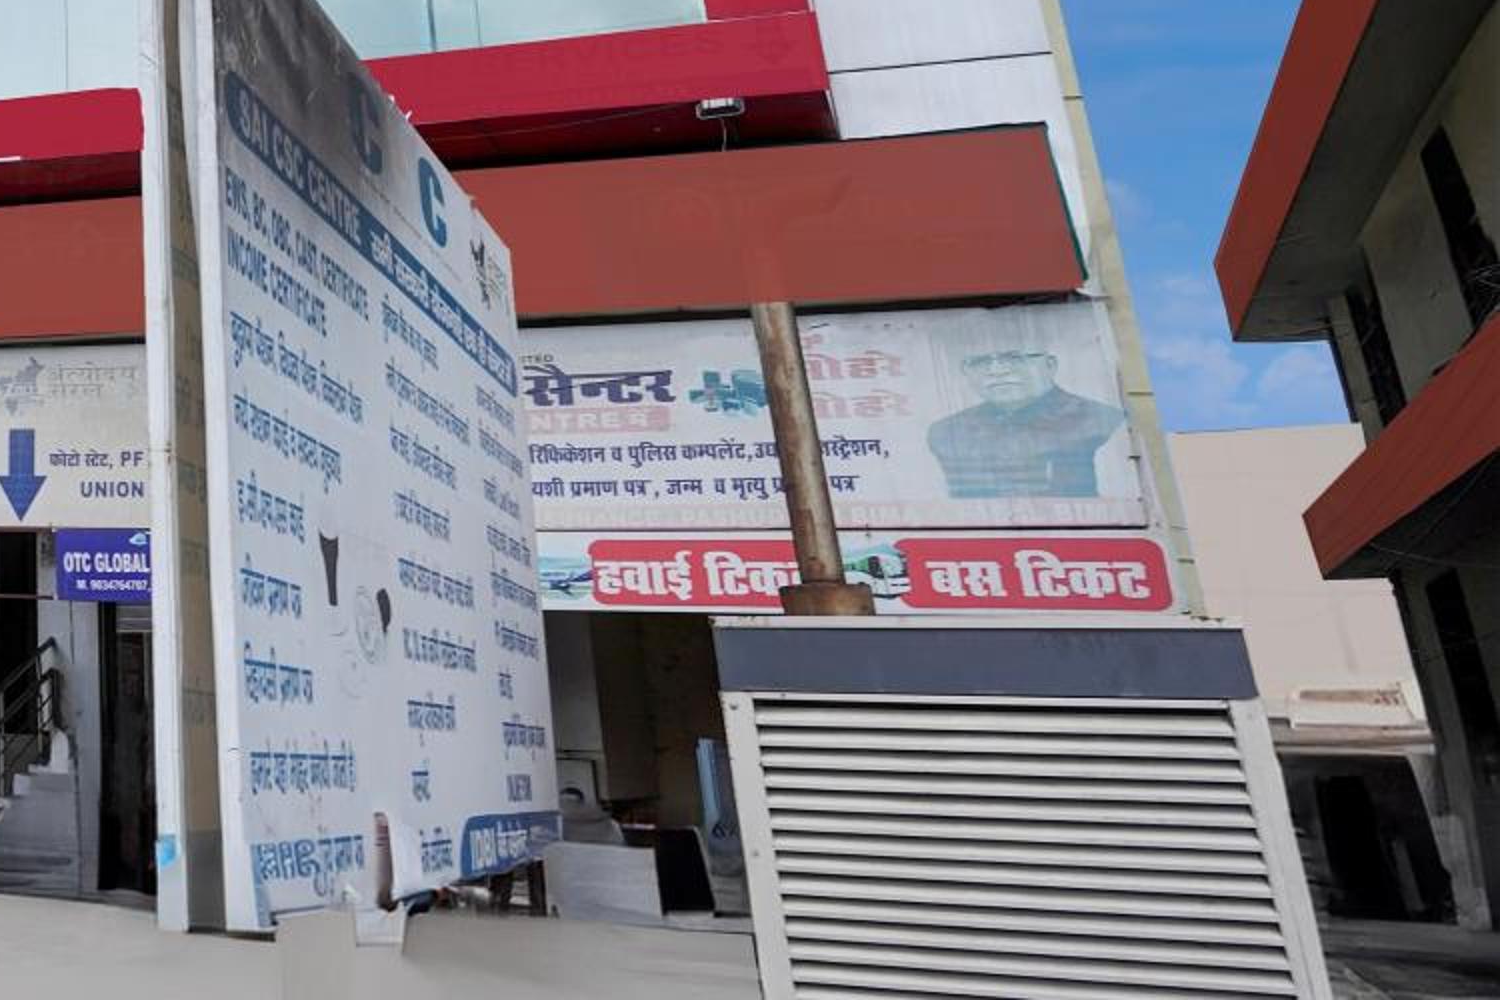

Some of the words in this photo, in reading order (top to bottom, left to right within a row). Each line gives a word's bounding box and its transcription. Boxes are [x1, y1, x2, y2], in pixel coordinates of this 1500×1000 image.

[271, 119, 304, 192] CSC
[306, 154, 361, 247] CENTRE
[50, 450, 81, 467] फोटो
[628, 442, 677, 468] पुलिस
[80, 481, 145, 498] UNION
[532, 478, 564, 497] यशी
[570, 480, 618, 497] प्रमाण
[665, 479, 704, 496] जन्म
[714, 478, 726, 495] व
[731, 477, 768, 499] मृत्यु
[829, 475, 860, 493] पत्र
[63, 552, 92, 573] OTC
[94, 552, 150, 573] GLOBAL
[925, 560, 1008, 598] बस
[1013, 549, 1151, 599] टिकट
[593, 551, 692, 600] हवाई
[703, 552, 801, 598] टिक
